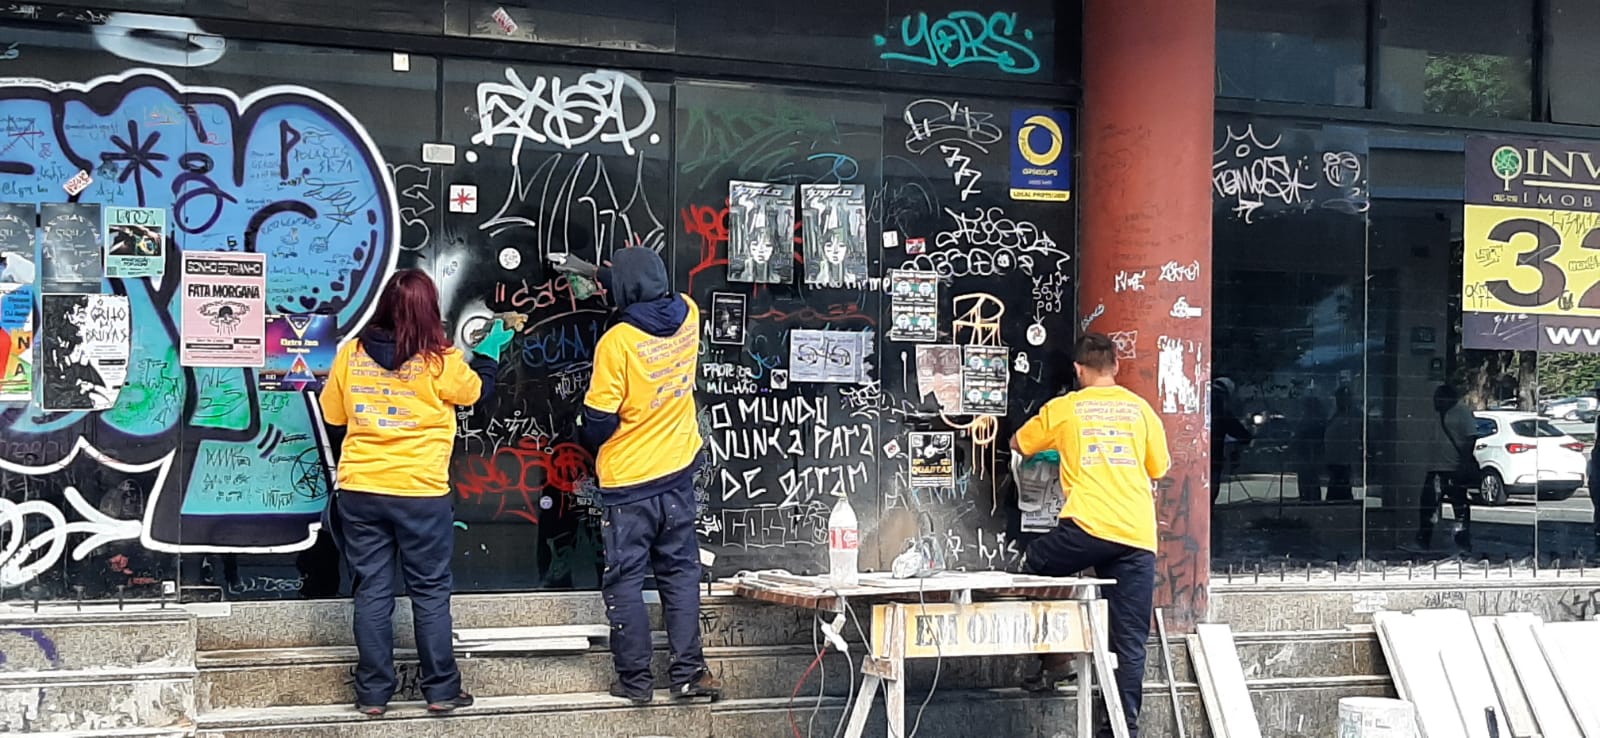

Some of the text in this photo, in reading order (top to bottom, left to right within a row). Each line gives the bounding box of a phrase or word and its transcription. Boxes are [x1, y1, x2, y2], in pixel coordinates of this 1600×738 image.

[187, 261, 261, 274] SONHO ESTRANHO
[188, 284, 260, 299] FATA MORGANA
[711, 396, 828, 429] O MUNDO
[912, 466, 953, 475] QUARTAS
[721, 467, 767, 501] DE
